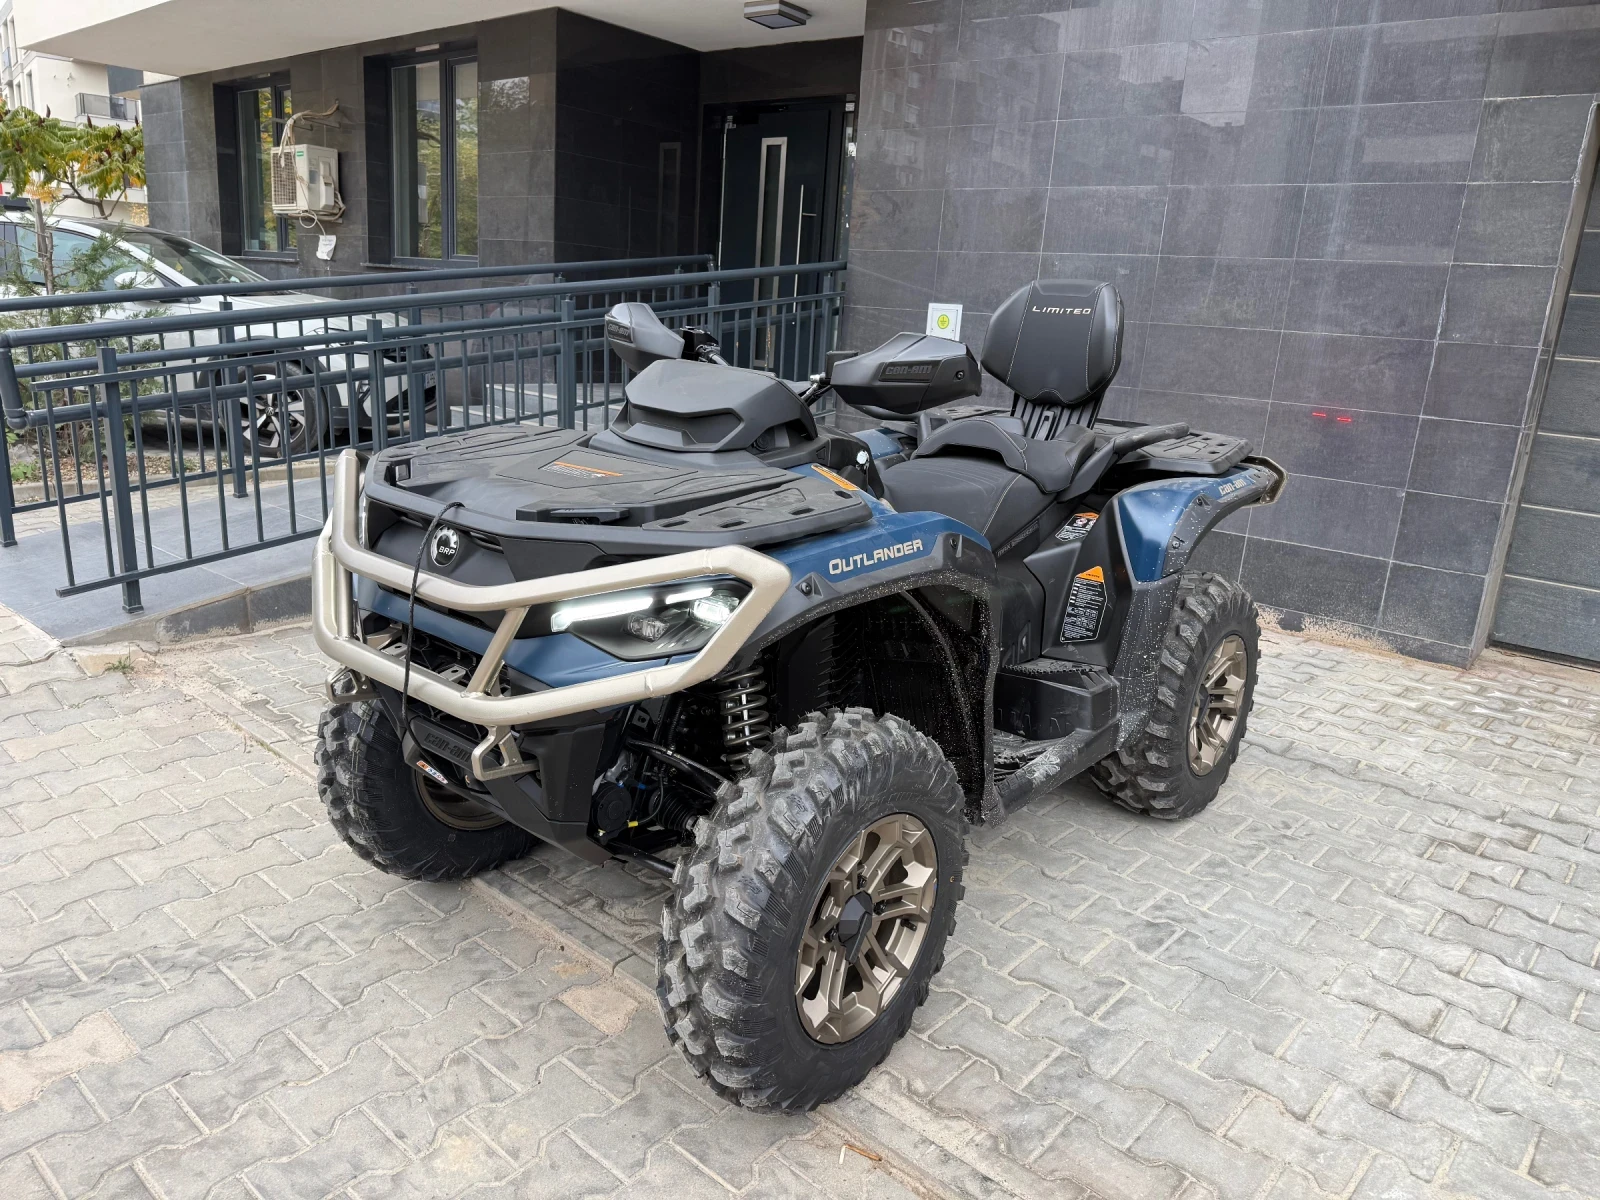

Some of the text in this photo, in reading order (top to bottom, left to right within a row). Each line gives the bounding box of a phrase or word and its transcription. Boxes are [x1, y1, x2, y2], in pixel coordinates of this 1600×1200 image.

[1032, 305, 1091, 315] LIMITED
[886, 365, 932, 374] can-am
[1218, 479, 1246, 495] can-am
[438, 545, 455, 555] BRP
[828, 539, 923, 575] OUTLANDER
[424, 733, 472, 762] can-am
